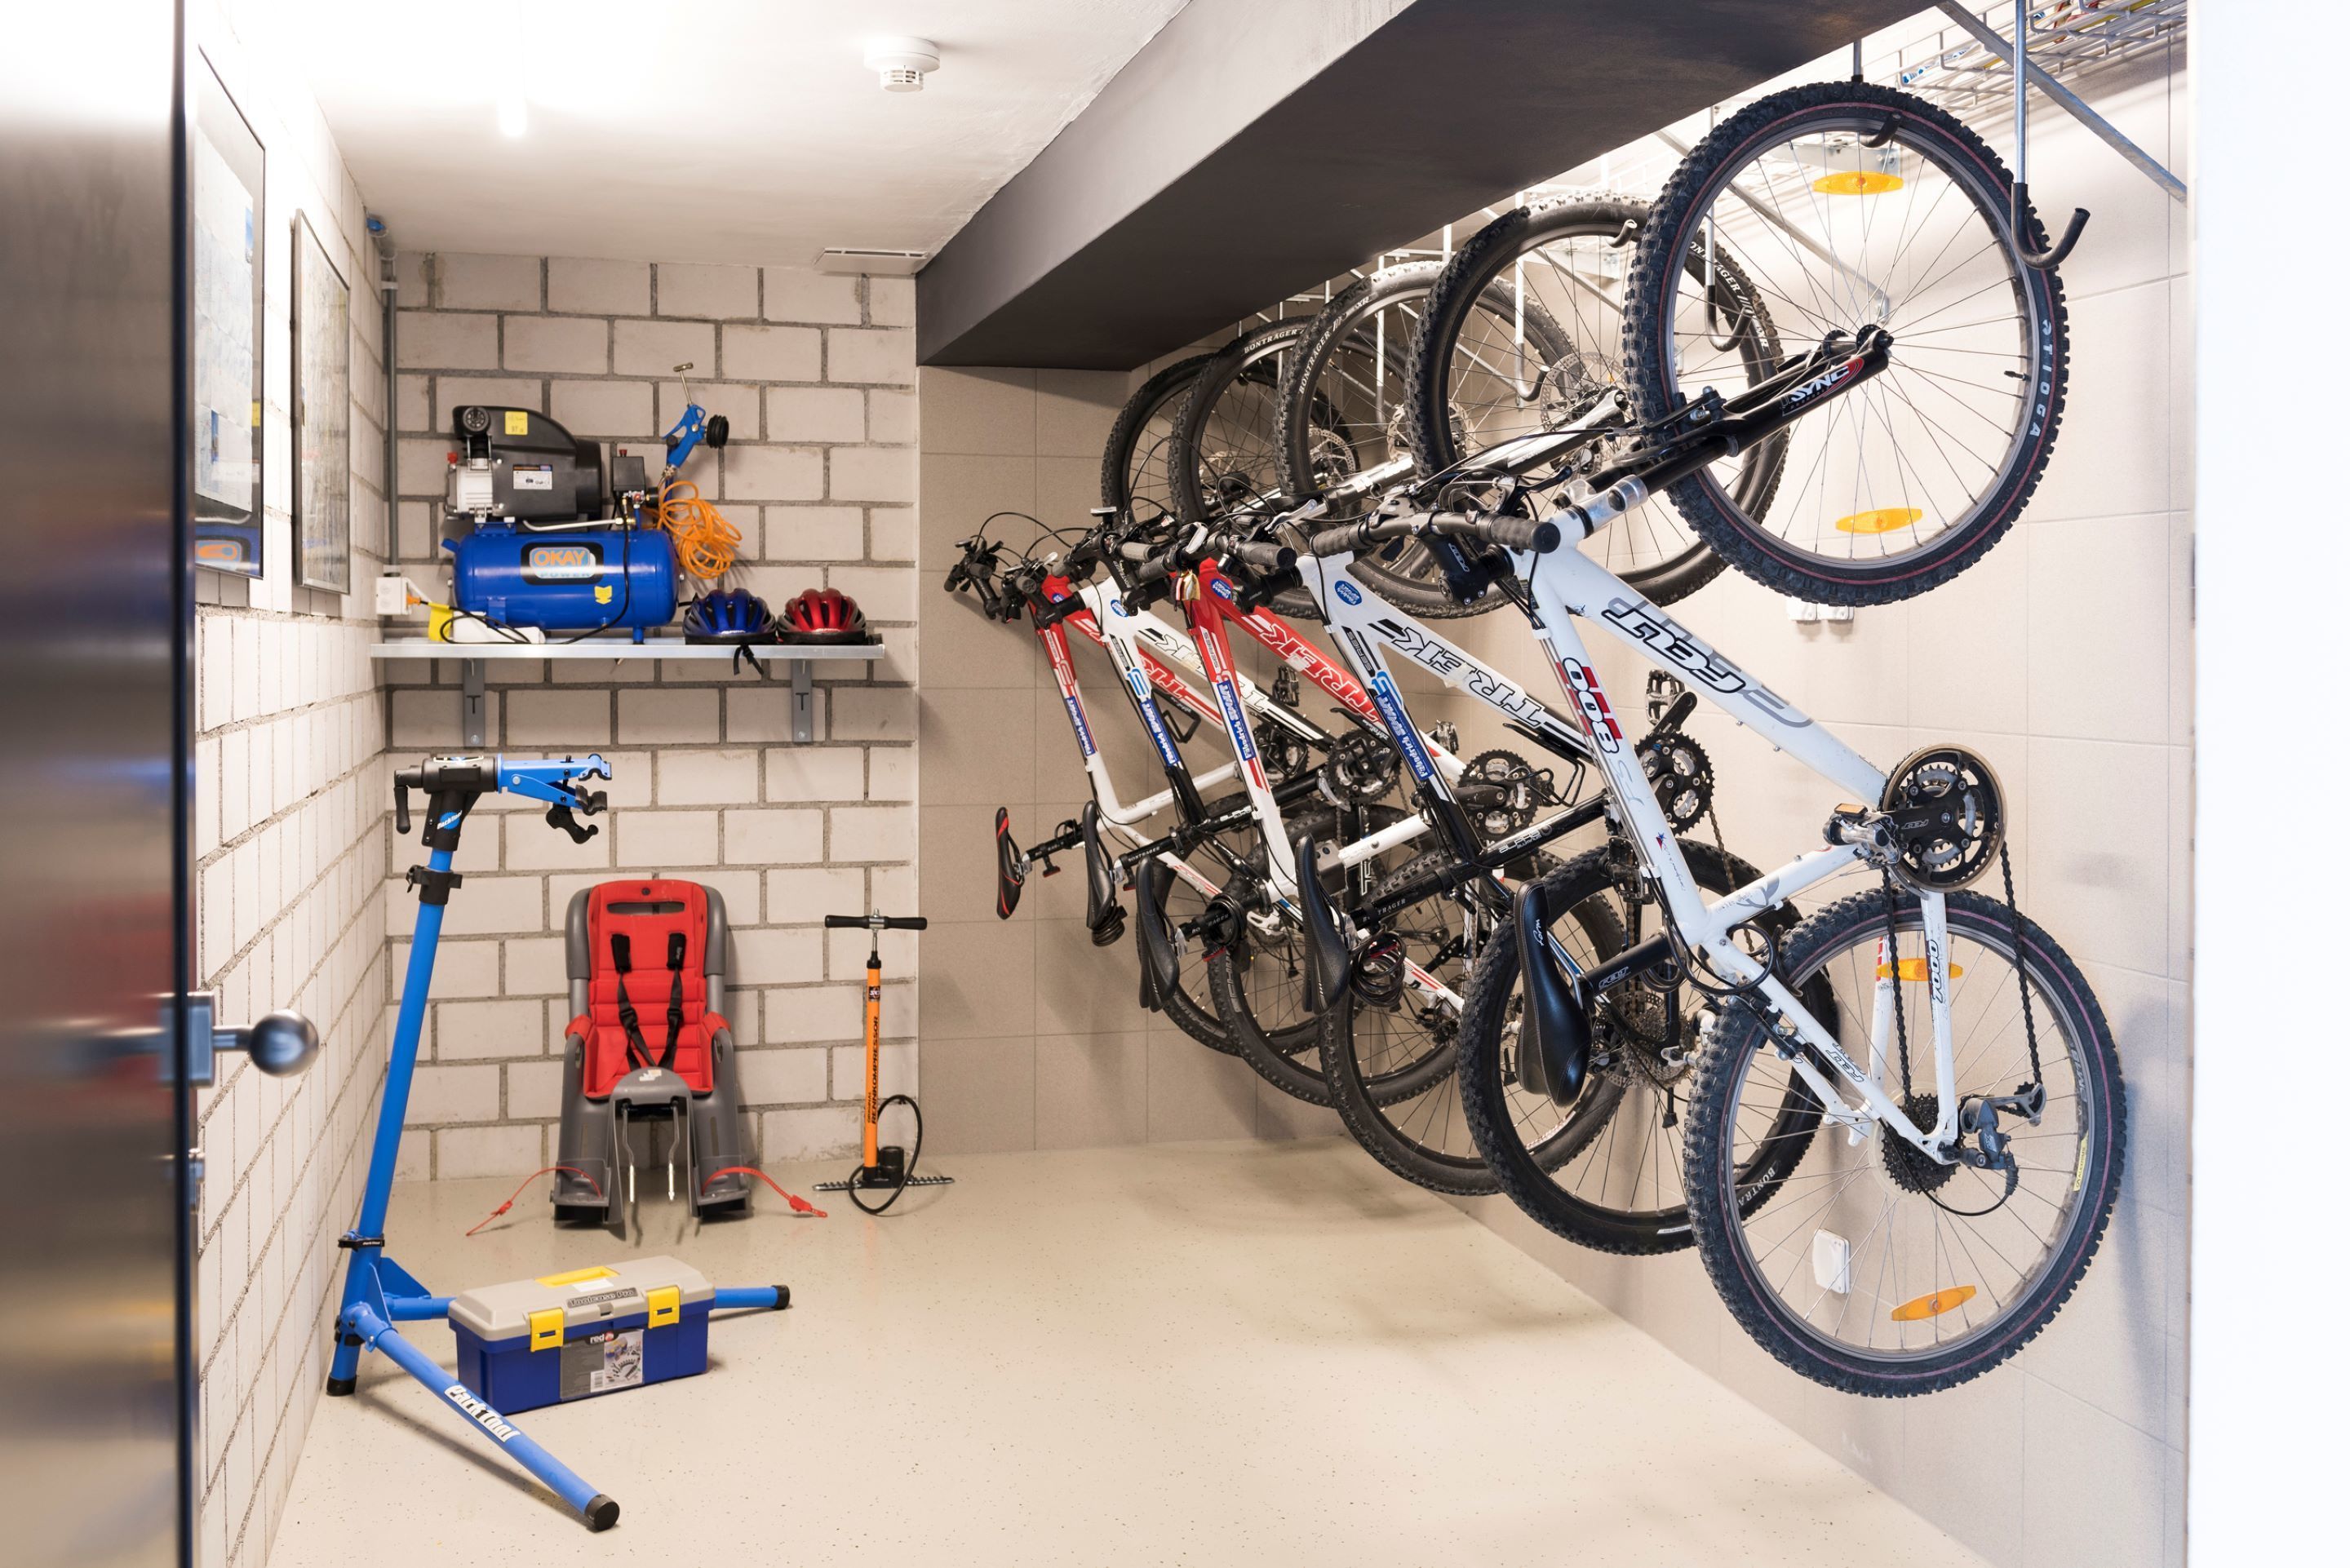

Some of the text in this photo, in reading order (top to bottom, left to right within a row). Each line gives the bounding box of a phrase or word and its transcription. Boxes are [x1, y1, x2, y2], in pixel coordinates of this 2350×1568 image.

[1689, 241, 1741, 295] ONAGER
[1243, 330, 1301, 355] BONTRAGER
[1298, 330, 1331, 395] BONTRAGER
[1791, 364, 1851, 403] SYNC
[2029, 343, 2053, 437] TIOGA
[534, 550, 586, 567] OKAY
[1347, 631, 1372, 672] SERIES
[1602, 606, 1746, 695] FELT
[1391, 626, 1542, 729] TREK
[1563, 657, 1620, 754] 800
[1191, 912, 1230, 933] BORAGER
[1362, 898, 1407, 924] BTRAGER
[1928, 939, 1943, 1003] 7000
[871, 1016, 879, 1125] RENNKOMPRESSOR
[1738, 1166, 1776, 1207] BONTRA
[616, 1288, 633, 1298] Pro
[589, 1334, 605, 1344] red
[444, 1384, 521, 1443] Park Tool
